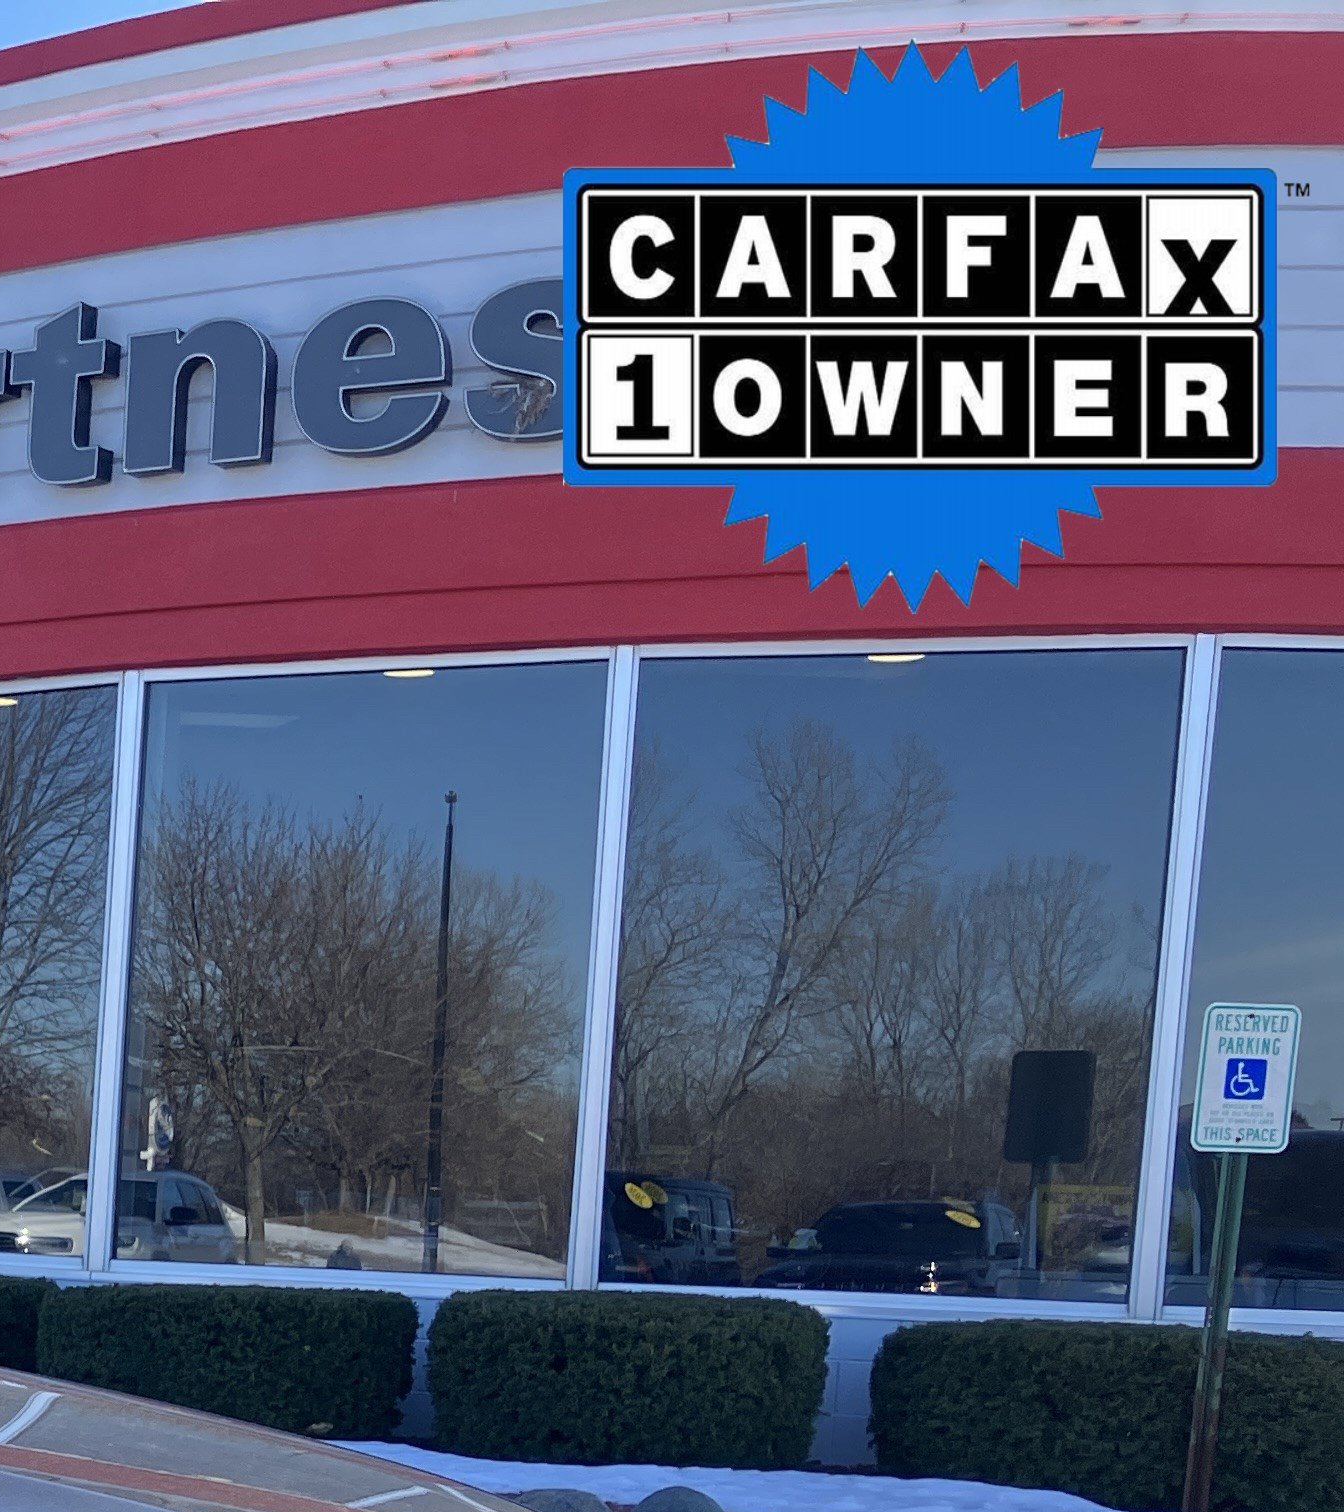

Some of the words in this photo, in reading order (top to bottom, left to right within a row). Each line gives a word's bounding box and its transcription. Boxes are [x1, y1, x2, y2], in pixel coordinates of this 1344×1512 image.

[1214, 1013, 1290, 1034] RESERVED
[1217, 1035, 1282, 1056] PARKING
[1202, 1125, 1232, 1142] THIS
[1237, 1126, 1279, 1143] SPACE
